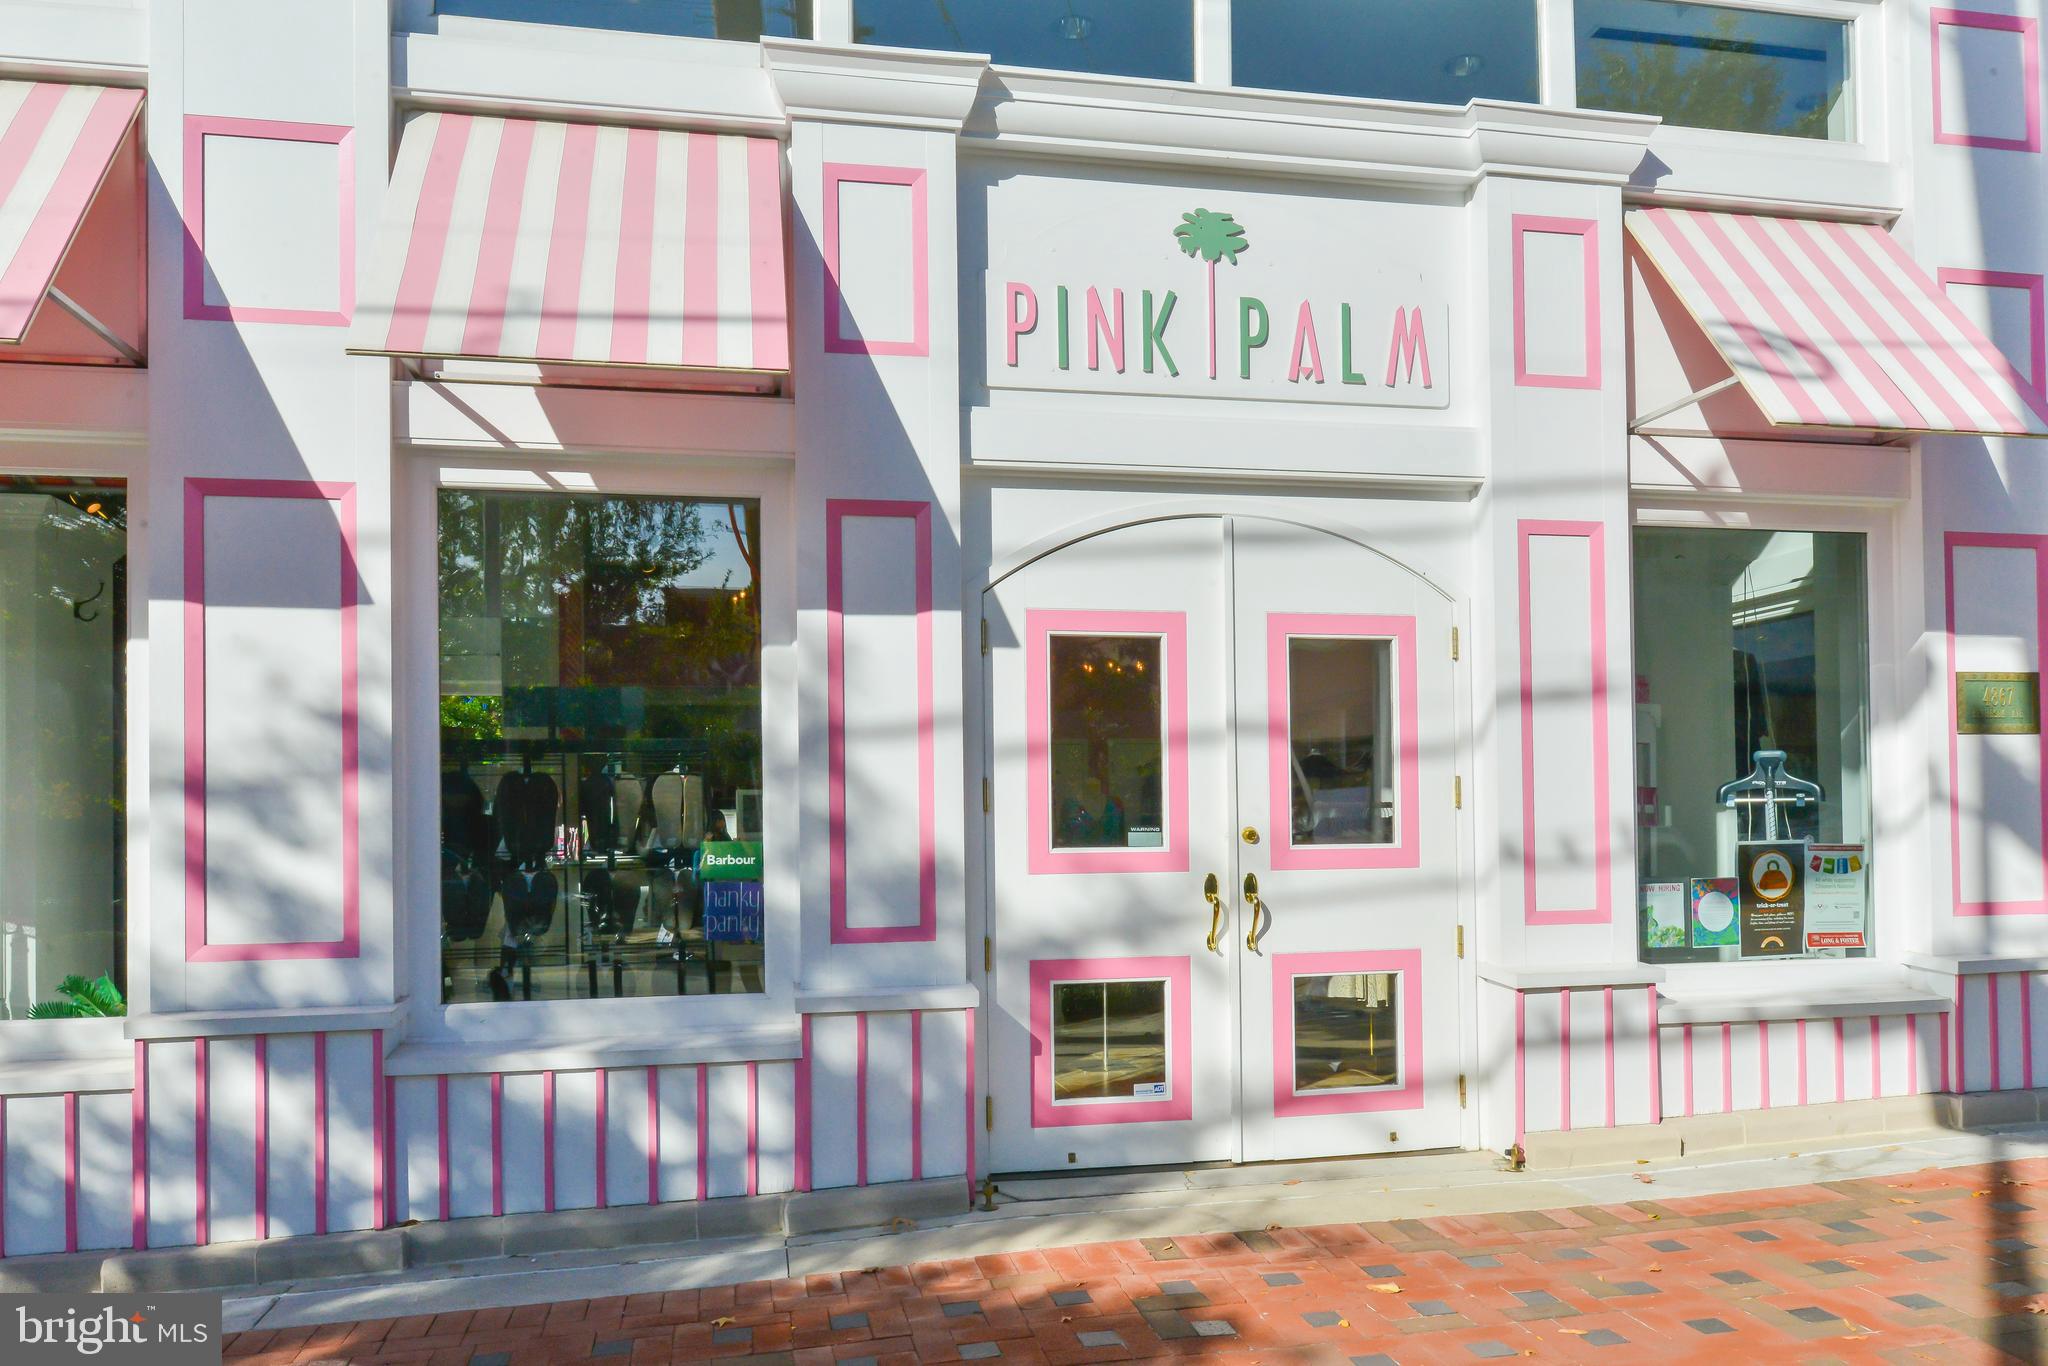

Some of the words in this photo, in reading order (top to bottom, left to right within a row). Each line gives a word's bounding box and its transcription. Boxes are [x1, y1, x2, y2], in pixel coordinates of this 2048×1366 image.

[1006, 282, 1180, 377] PINK
[1240, 297, 1433, 389] PALM
[706, 854, 755, 865] Barbour
[707, 882, 760, 915] hanky
[1658, 884, 1680, 892] HIRING
[707, 913, 760, 940] panky
